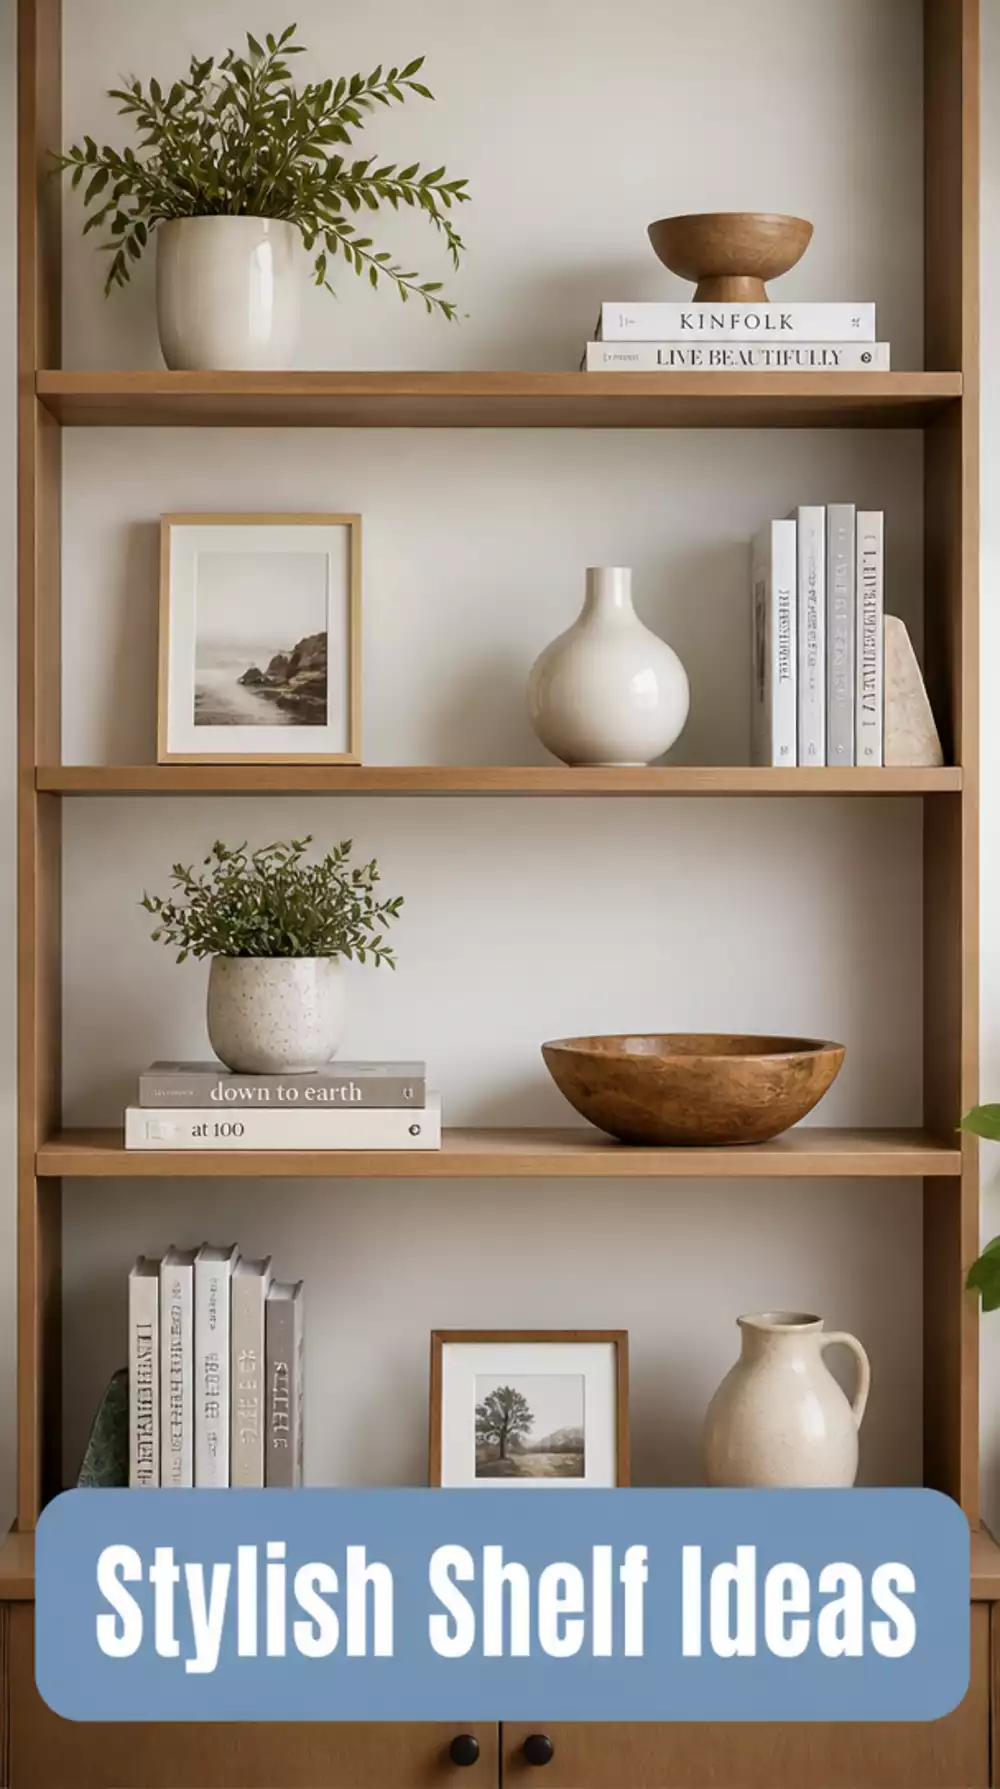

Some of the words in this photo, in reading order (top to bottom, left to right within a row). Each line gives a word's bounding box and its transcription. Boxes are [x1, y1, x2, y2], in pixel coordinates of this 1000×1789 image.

[680, 313, 794, 330] KINFOLK
[656, 349, 703, 366] LIVE
[708, 349, 843, 366] BEAUTIFULLY
[210, 1081, 270, 1102] down
[277, 1084, 299, 1102] to
[304, 1081, 363, 1102] earth
[191, 1123, 209, 1138] at
[213, 1122, 245, 1138] 100
